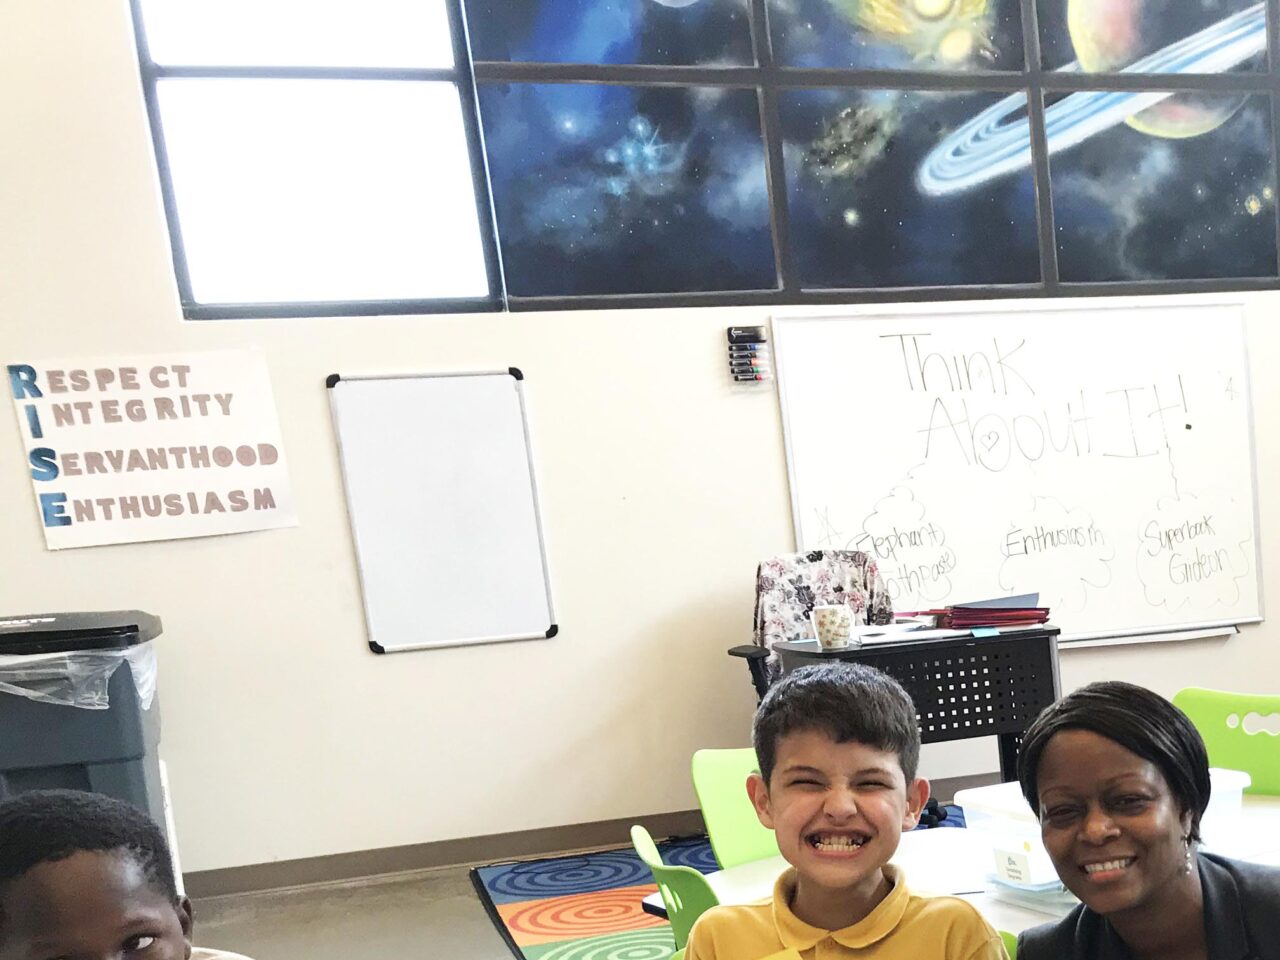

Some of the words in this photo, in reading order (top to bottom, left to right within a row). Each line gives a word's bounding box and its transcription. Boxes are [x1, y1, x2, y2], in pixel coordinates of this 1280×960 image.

[6, 364, 191, 400] RESPECT
[879, 333, 1035, 396] Think
[24, 393, 234, 439] INTEGRITY
[29, 443, 279, 482] SERVANTHOOD
[39, 487, 277, 528] ENTHUSIASM
[1006, 522, 1105, 556] Enthusiasm
